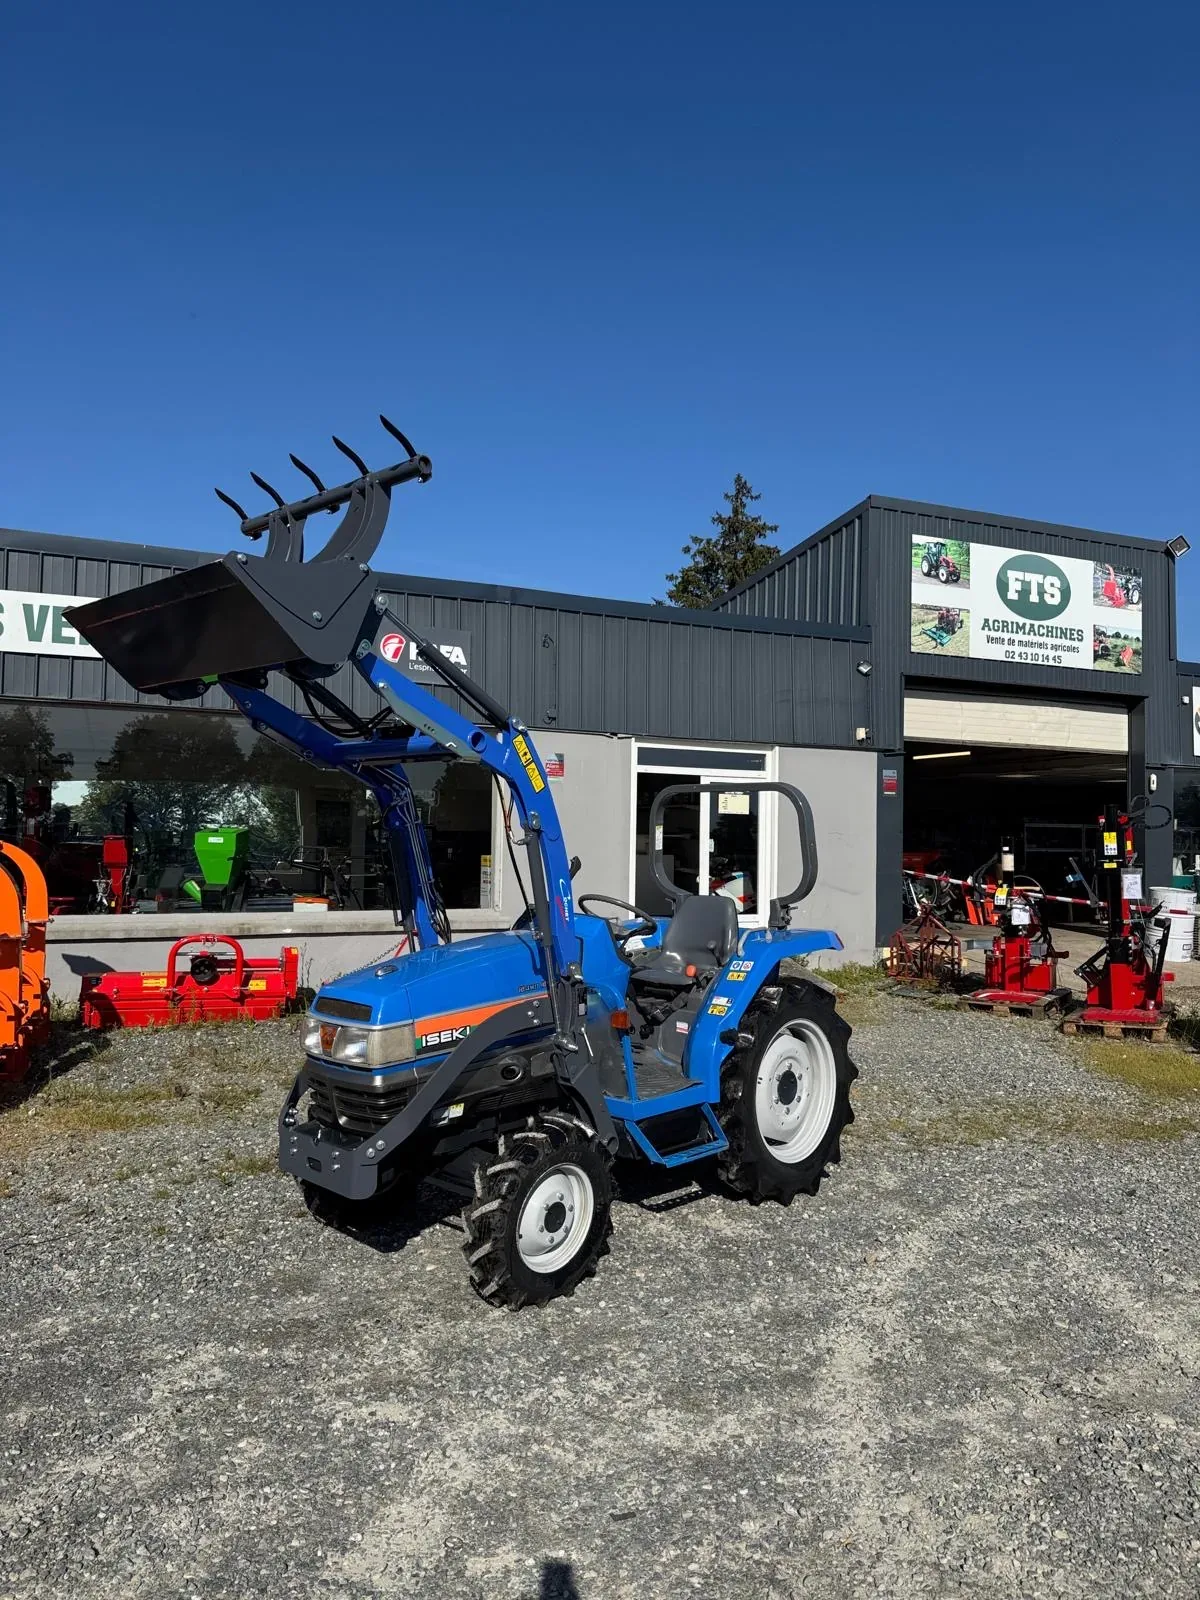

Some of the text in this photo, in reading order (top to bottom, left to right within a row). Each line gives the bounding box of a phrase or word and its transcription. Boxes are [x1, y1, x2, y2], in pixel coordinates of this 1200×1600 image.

[1006, 569, 1062, 606] FTS
[22, 603, 90, 646] VE
[981, 617, 1084, 642] AGRIMACHINES
[986, 634, 1006, 645] Vente
[1007, 637, 1016, 647] de
[1049, 643, 1080, 654] agricoles
[1004, 650, 1063, 665] 02 43 10 14 45
[421, 1026, 470, 1048] ISEKI
